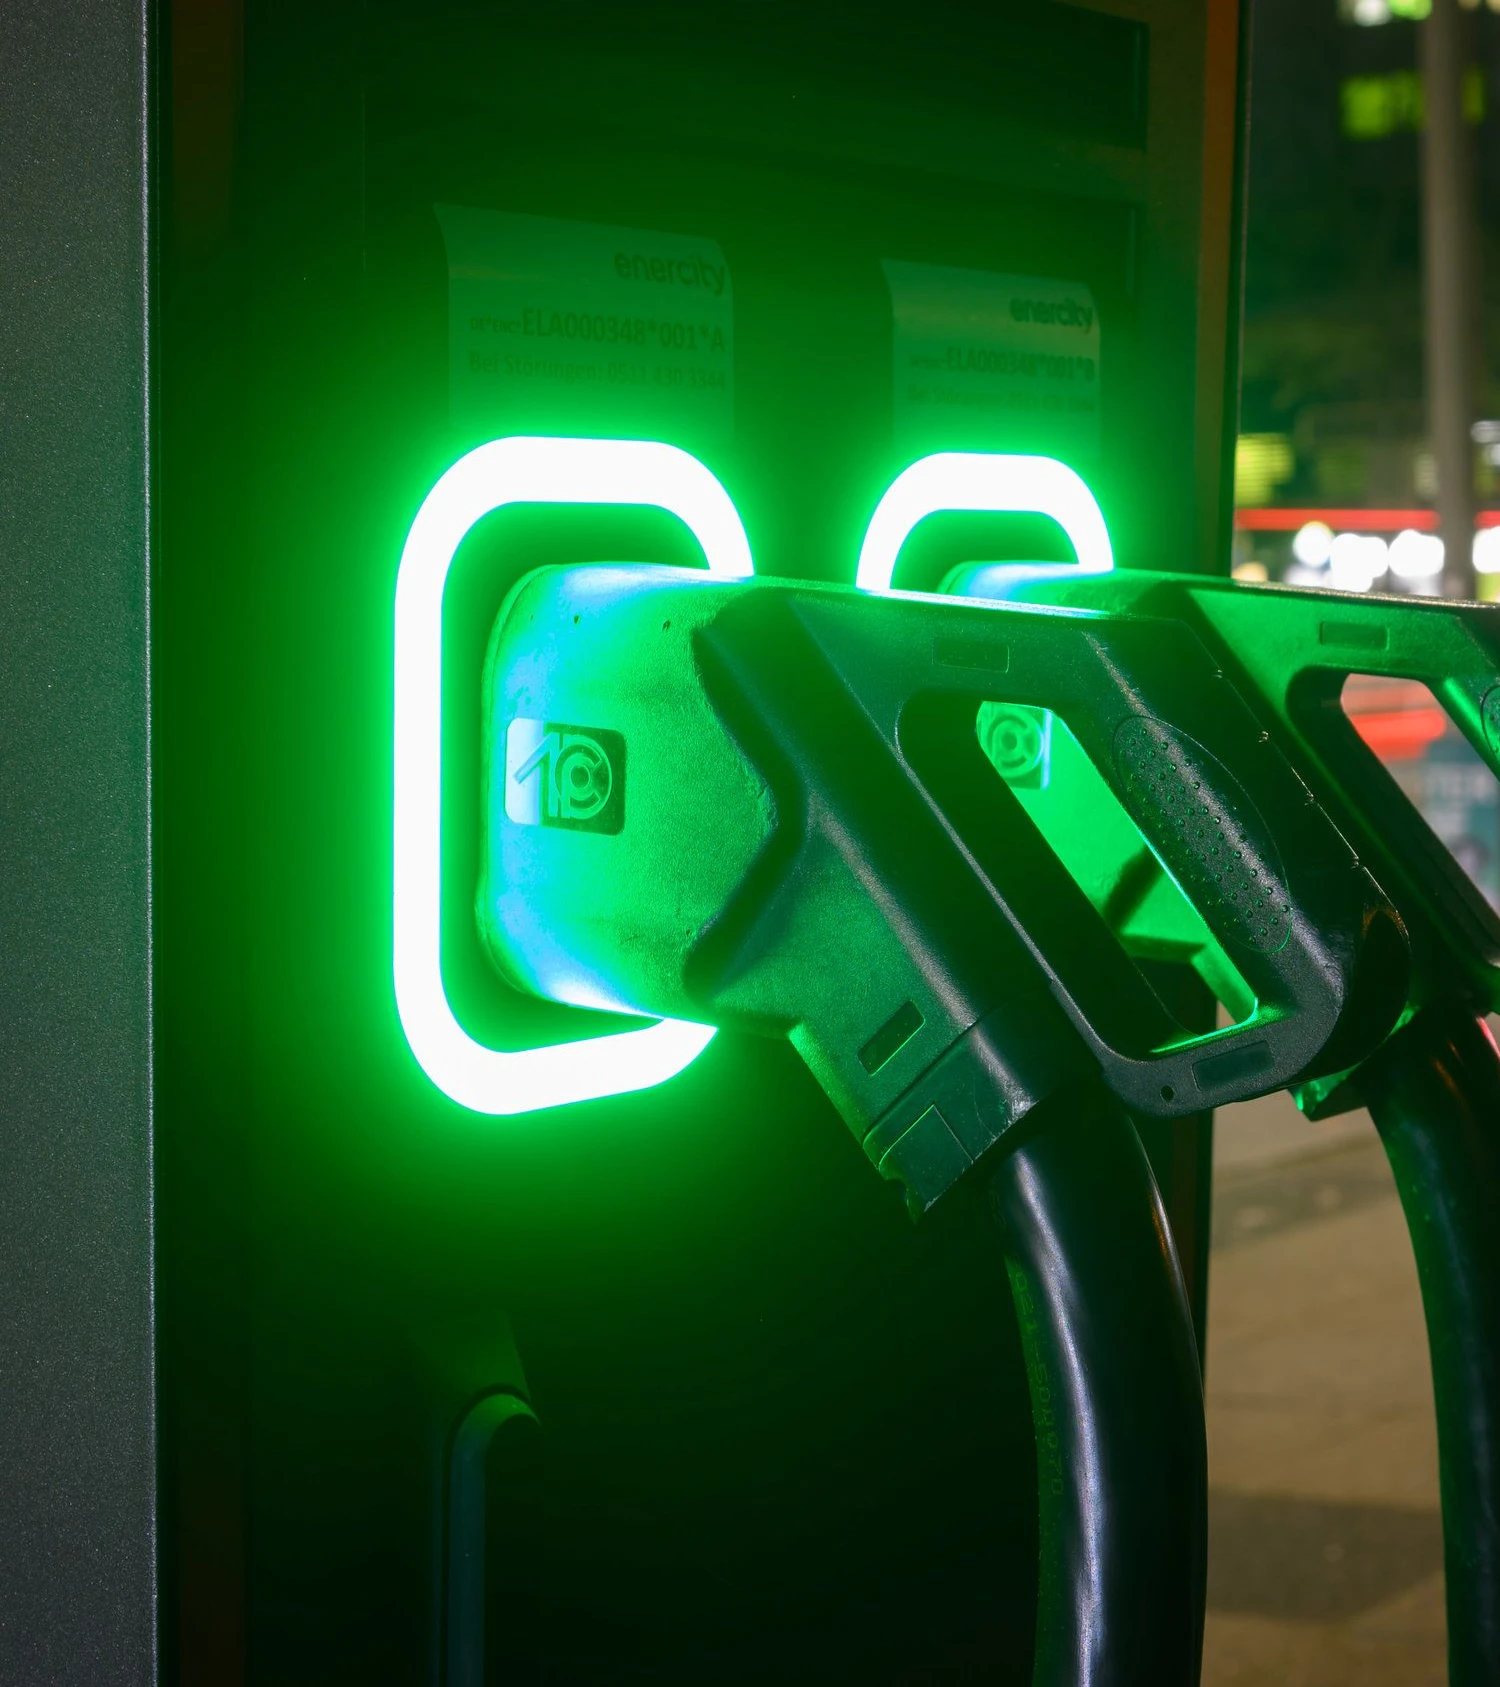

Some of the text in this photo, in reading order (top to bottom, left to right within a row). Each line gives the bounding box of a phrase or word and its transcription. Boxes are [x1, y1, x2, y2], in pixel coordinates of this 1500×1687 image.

[613, 251, 726, 297] enercity
[1009, 297, 1093, 334] enercity
[469, 350, 499, 374] Bei
